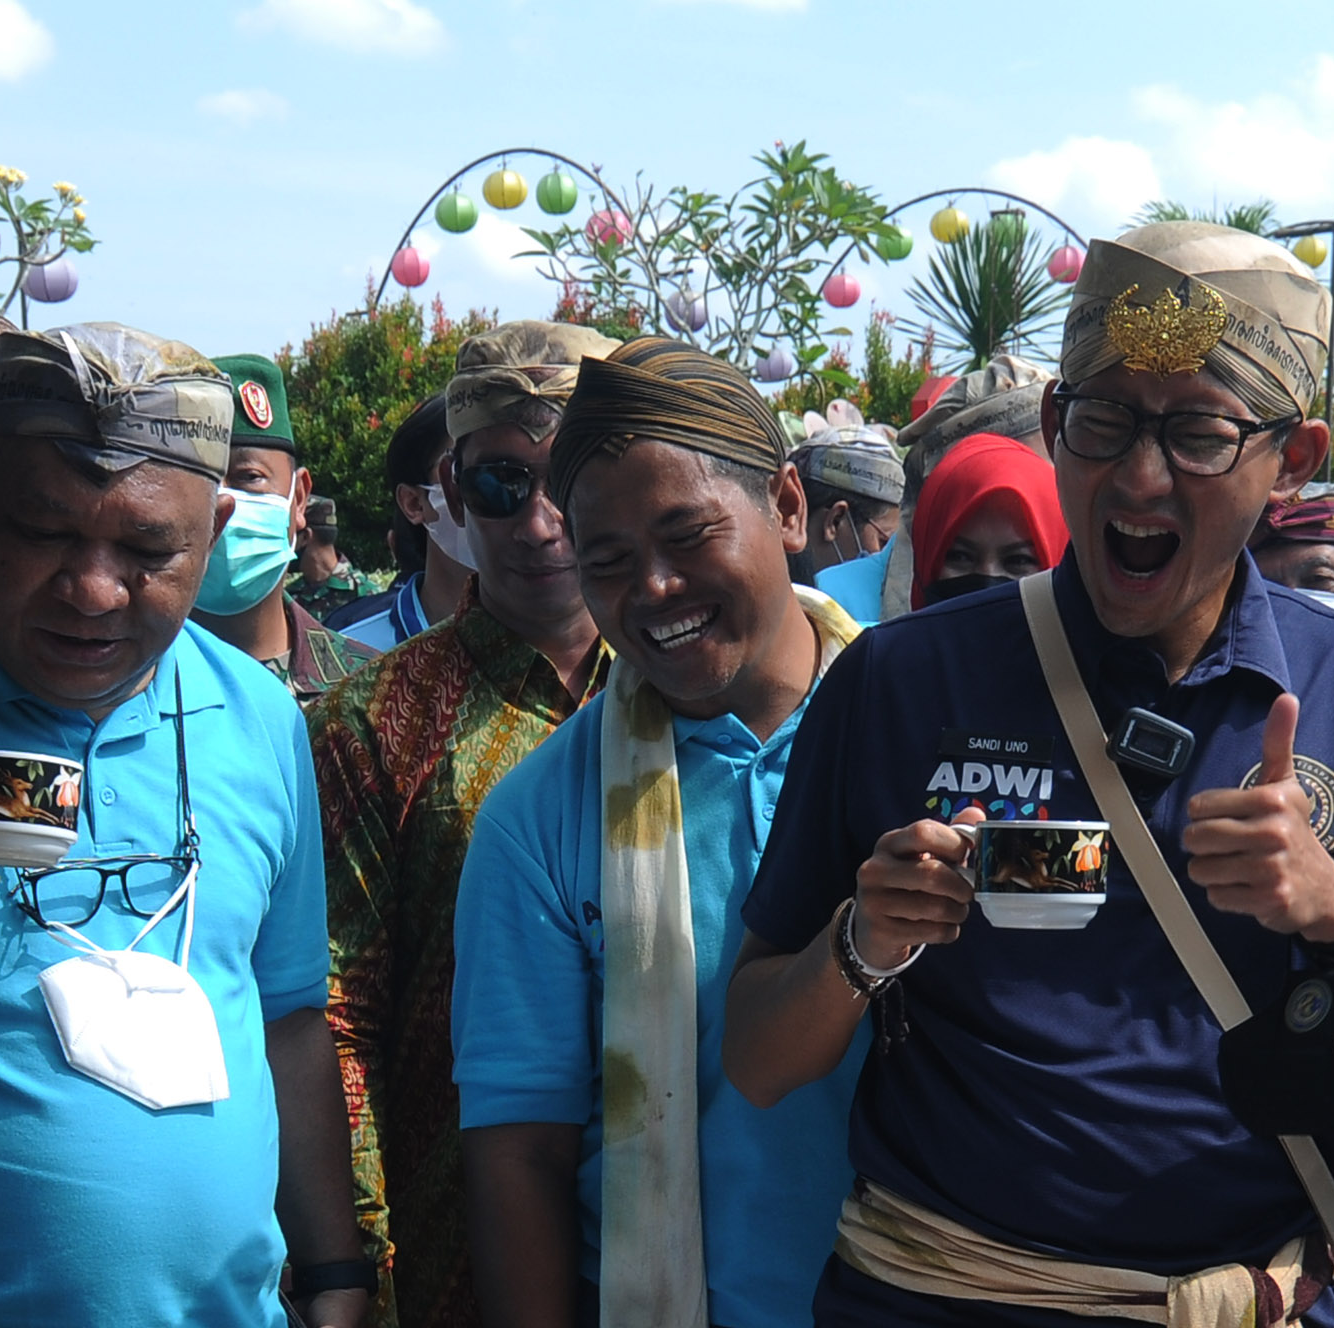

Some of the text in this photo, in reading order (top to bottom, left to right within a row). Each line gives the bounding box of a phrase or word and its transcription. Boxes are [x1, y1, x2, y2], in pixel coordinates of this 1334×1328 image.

[967, 737, 1029, 754] SANDI UNO
[925, 761, 1054, 801] ADWI
